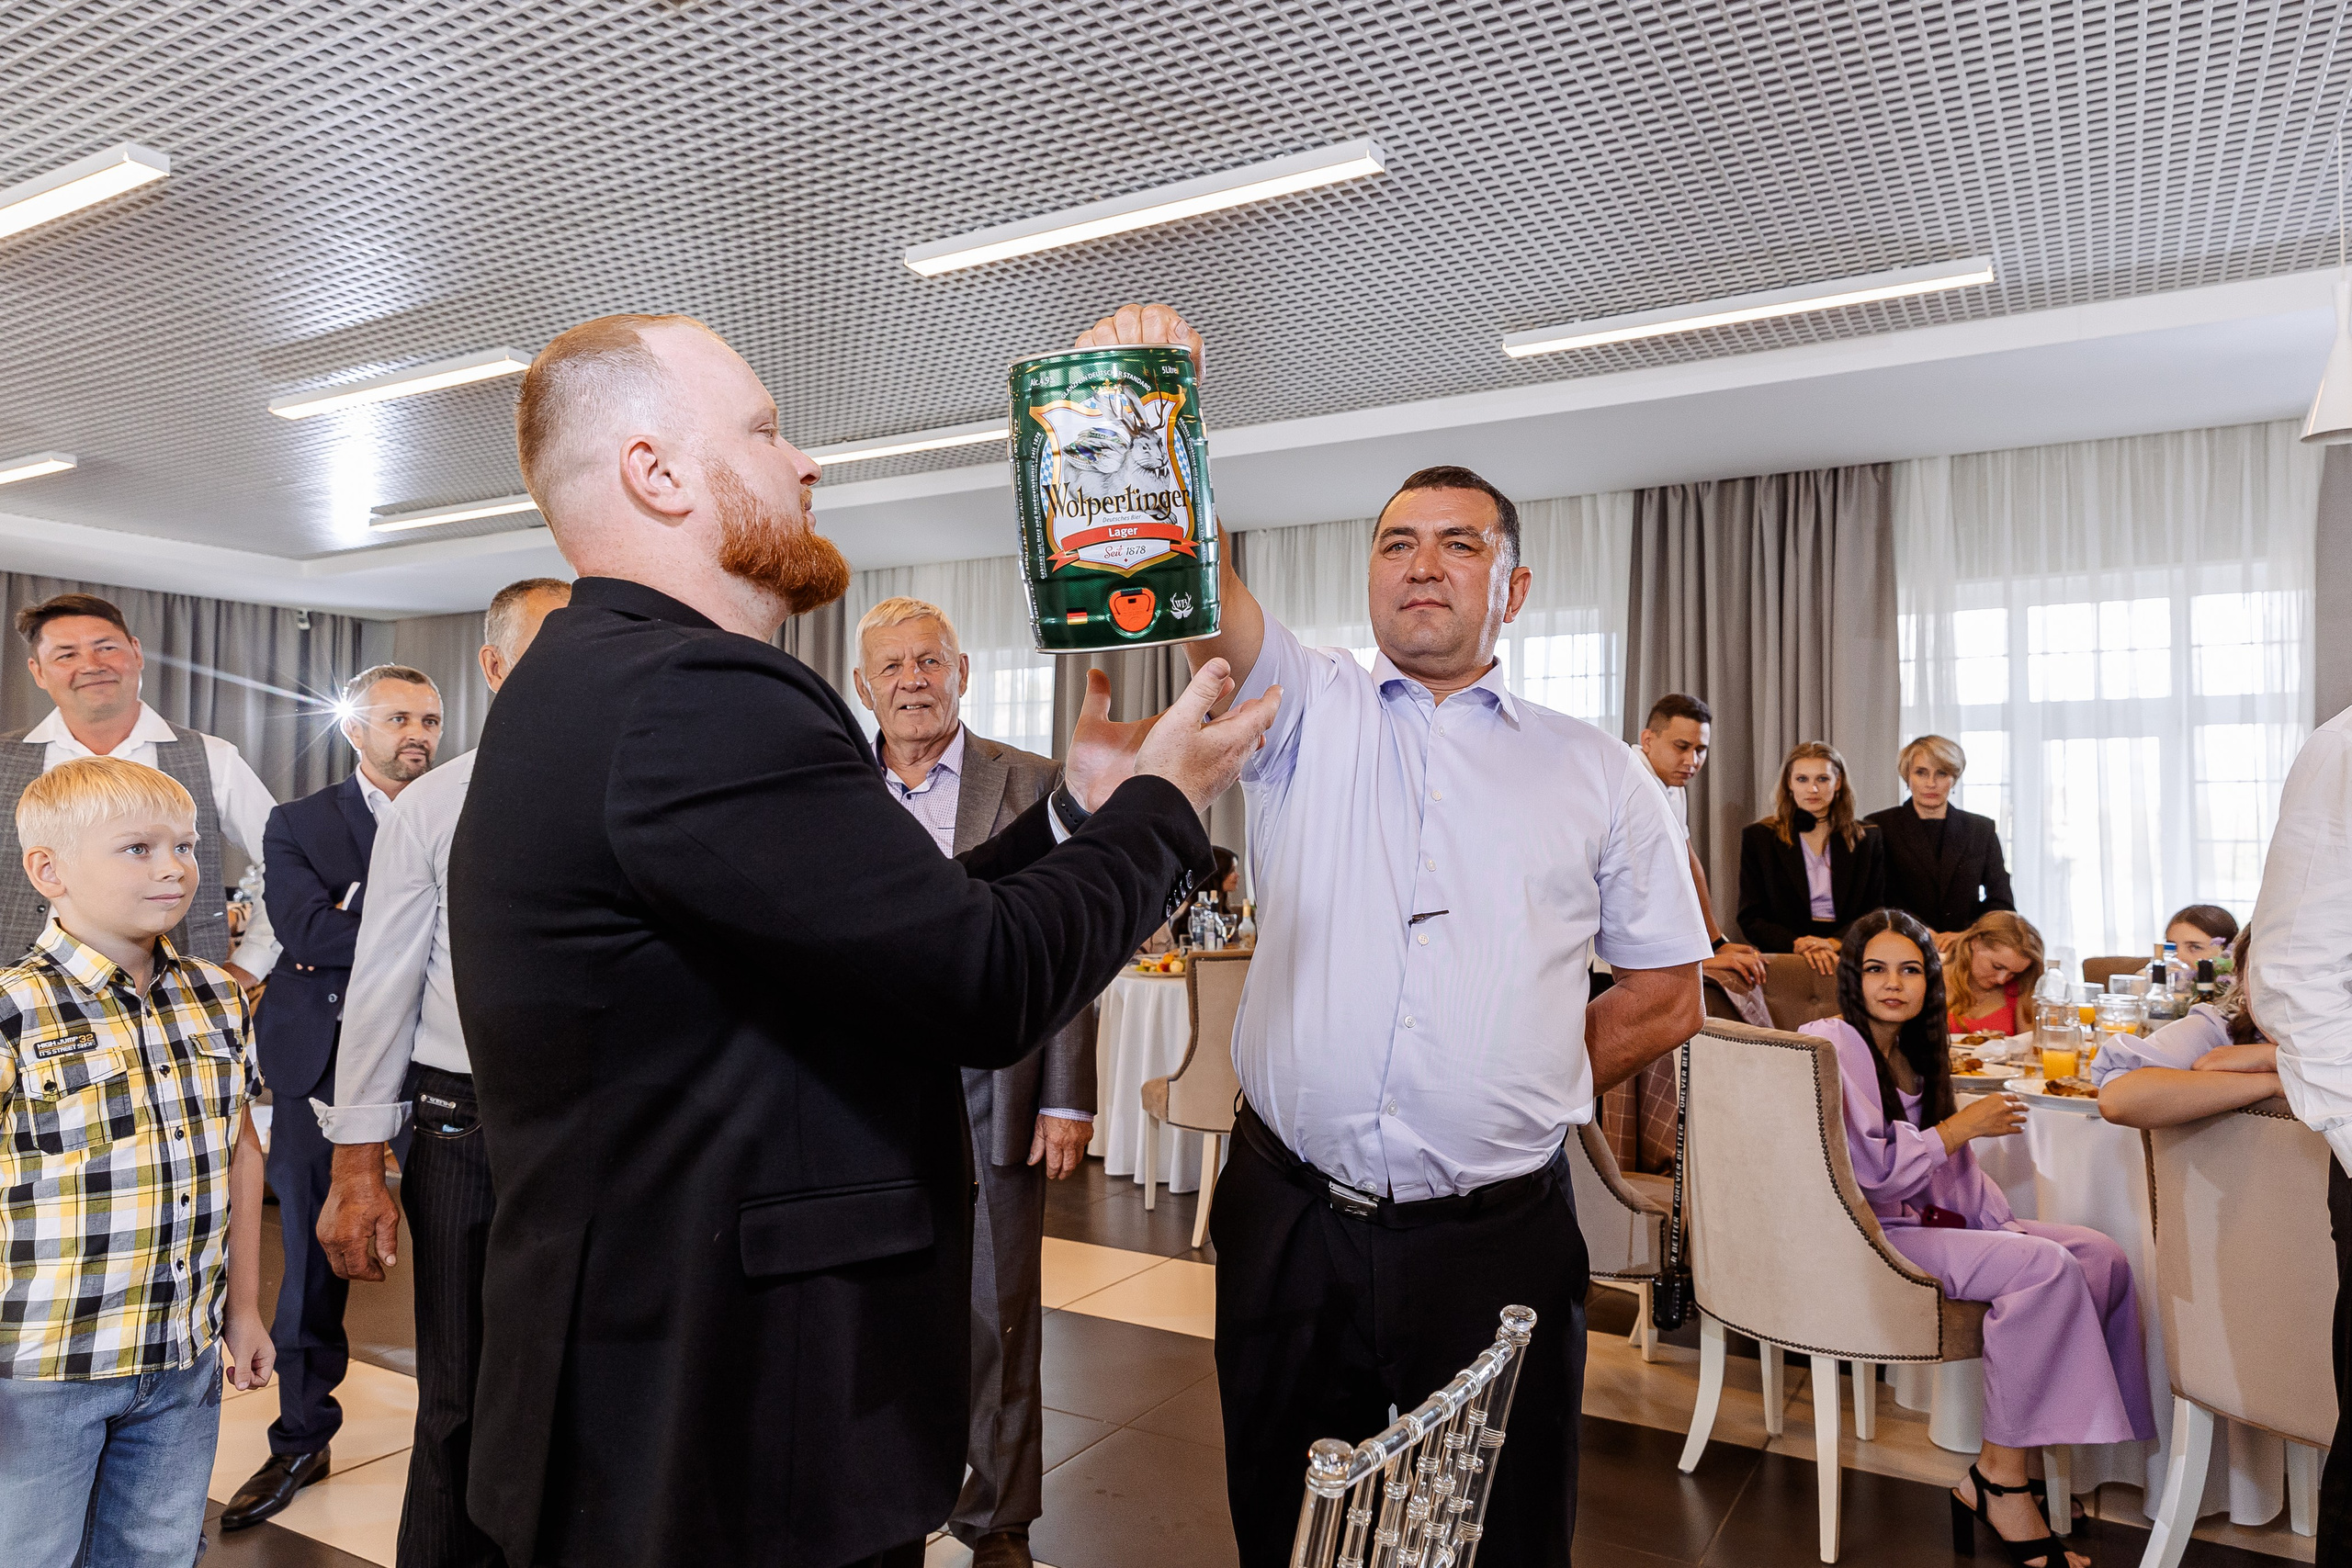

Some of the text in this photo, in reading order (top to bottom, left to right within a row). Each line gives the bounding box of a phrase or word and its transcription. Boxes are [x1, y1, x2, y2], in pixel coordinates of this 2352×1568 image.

[1060, 369, 1152, 400] GLANZFEIN DEUTSCR STANDARD
[1033, 431, 1042, 446] 1878
[1030, 465, 1038, 514] Handwerkskunst
[1041, 481, 1191, 526] Wolpertinger
[1102, 513, 1142, 524] Deutsches Bier
[1108, 525, 1138, 538] Lager
[1103, 545, 1147, 559] Seit 1878
[1174, 598, 1188, 609] WB
[37, 1033, 95, 1049] HIGH JUMP 32
[51, 1044, 77, 1055] STREET
[1679, 1069, 1688, 1114] FOREVER
[1674, 1162, 1682, 1208] FOREVER
[1671, 1215, 1679, 1254] BETTER
